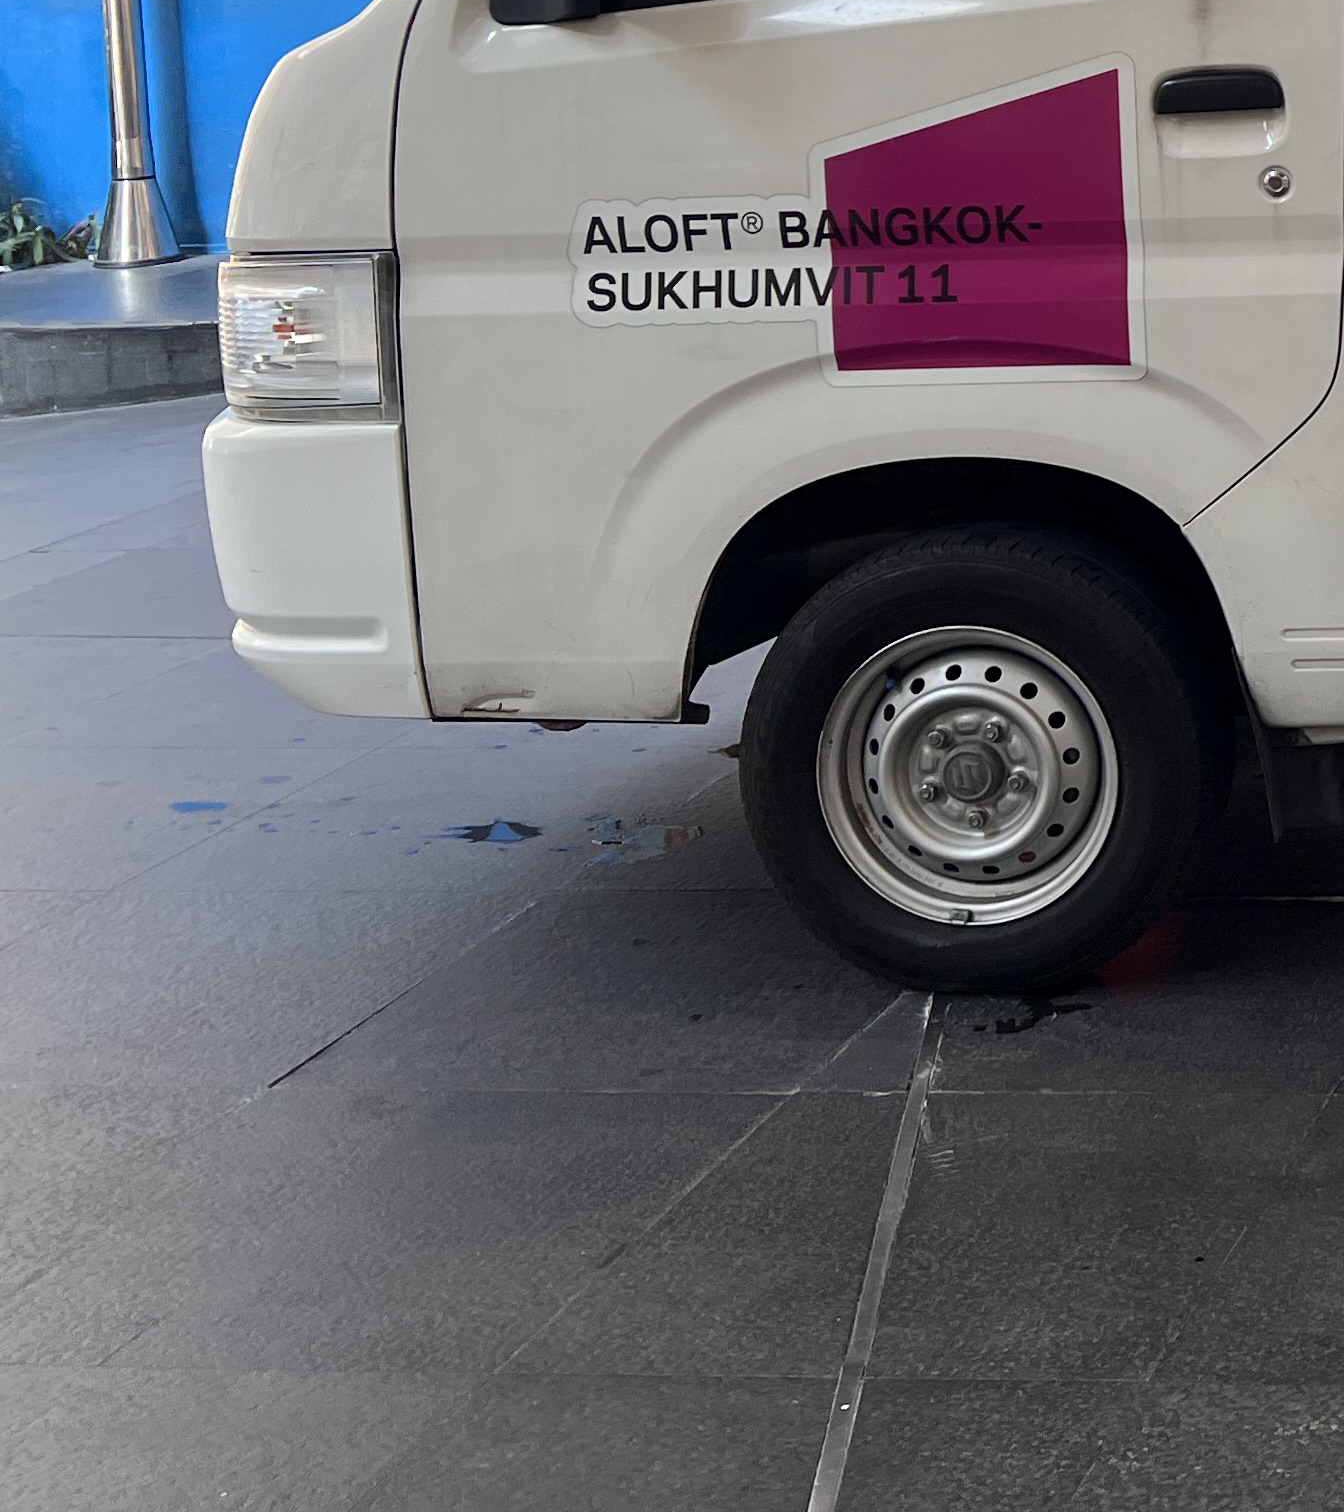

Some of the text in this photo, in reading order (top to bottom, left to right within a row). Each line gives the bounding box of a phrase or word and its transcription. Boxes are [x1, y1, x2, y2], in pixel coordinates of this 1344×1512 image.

[778, 204, 1043, 249] BANGKOK-
[587, 263, 958, 312] SUKHUMVIT 11
